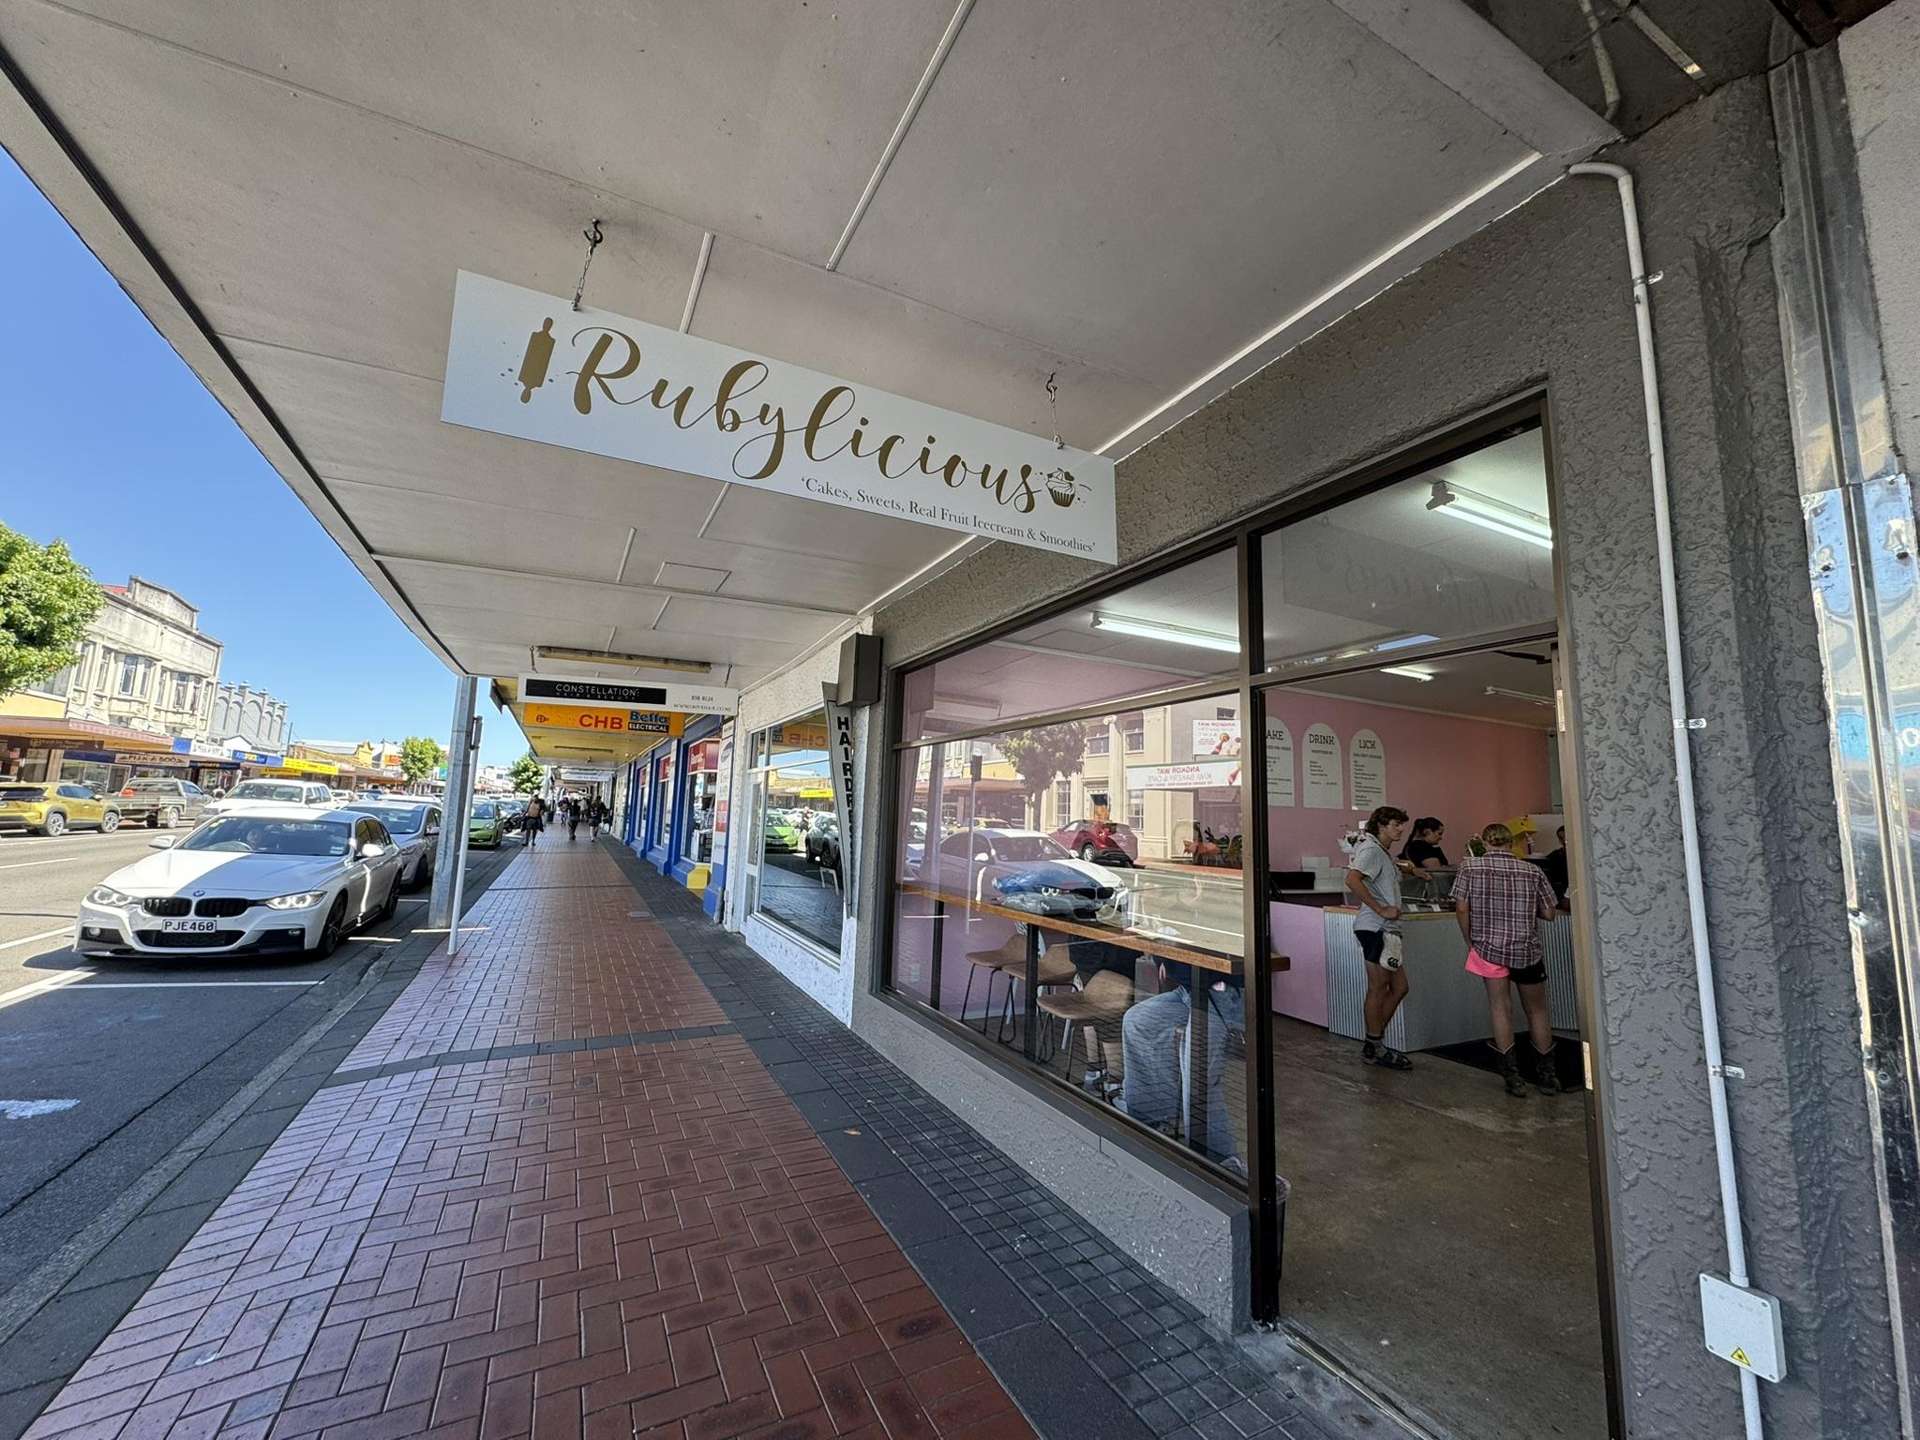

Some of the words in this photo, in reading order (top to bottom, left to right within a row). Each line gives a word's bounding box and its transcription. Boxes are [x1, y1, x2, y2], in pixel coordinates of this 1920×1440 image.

[566, 326, 1041, 513] Rubylicious
[856, 489, 905, 513] Sweets,
[909, 502, 937, 520] Real
[941, 507, 969, 526] Fruit
[973, 515, 1024, 539] Icecream
[1026, 529, 1037, 541] &
[579, 714, 623, 729] CHB
[629, 723, 667, 732] ELECTRICAL
[1265, 729, 1284, 741] AKE
[1309, 733, 1335, 745] DRINK
[164, 921, 214, 931] PJE460
